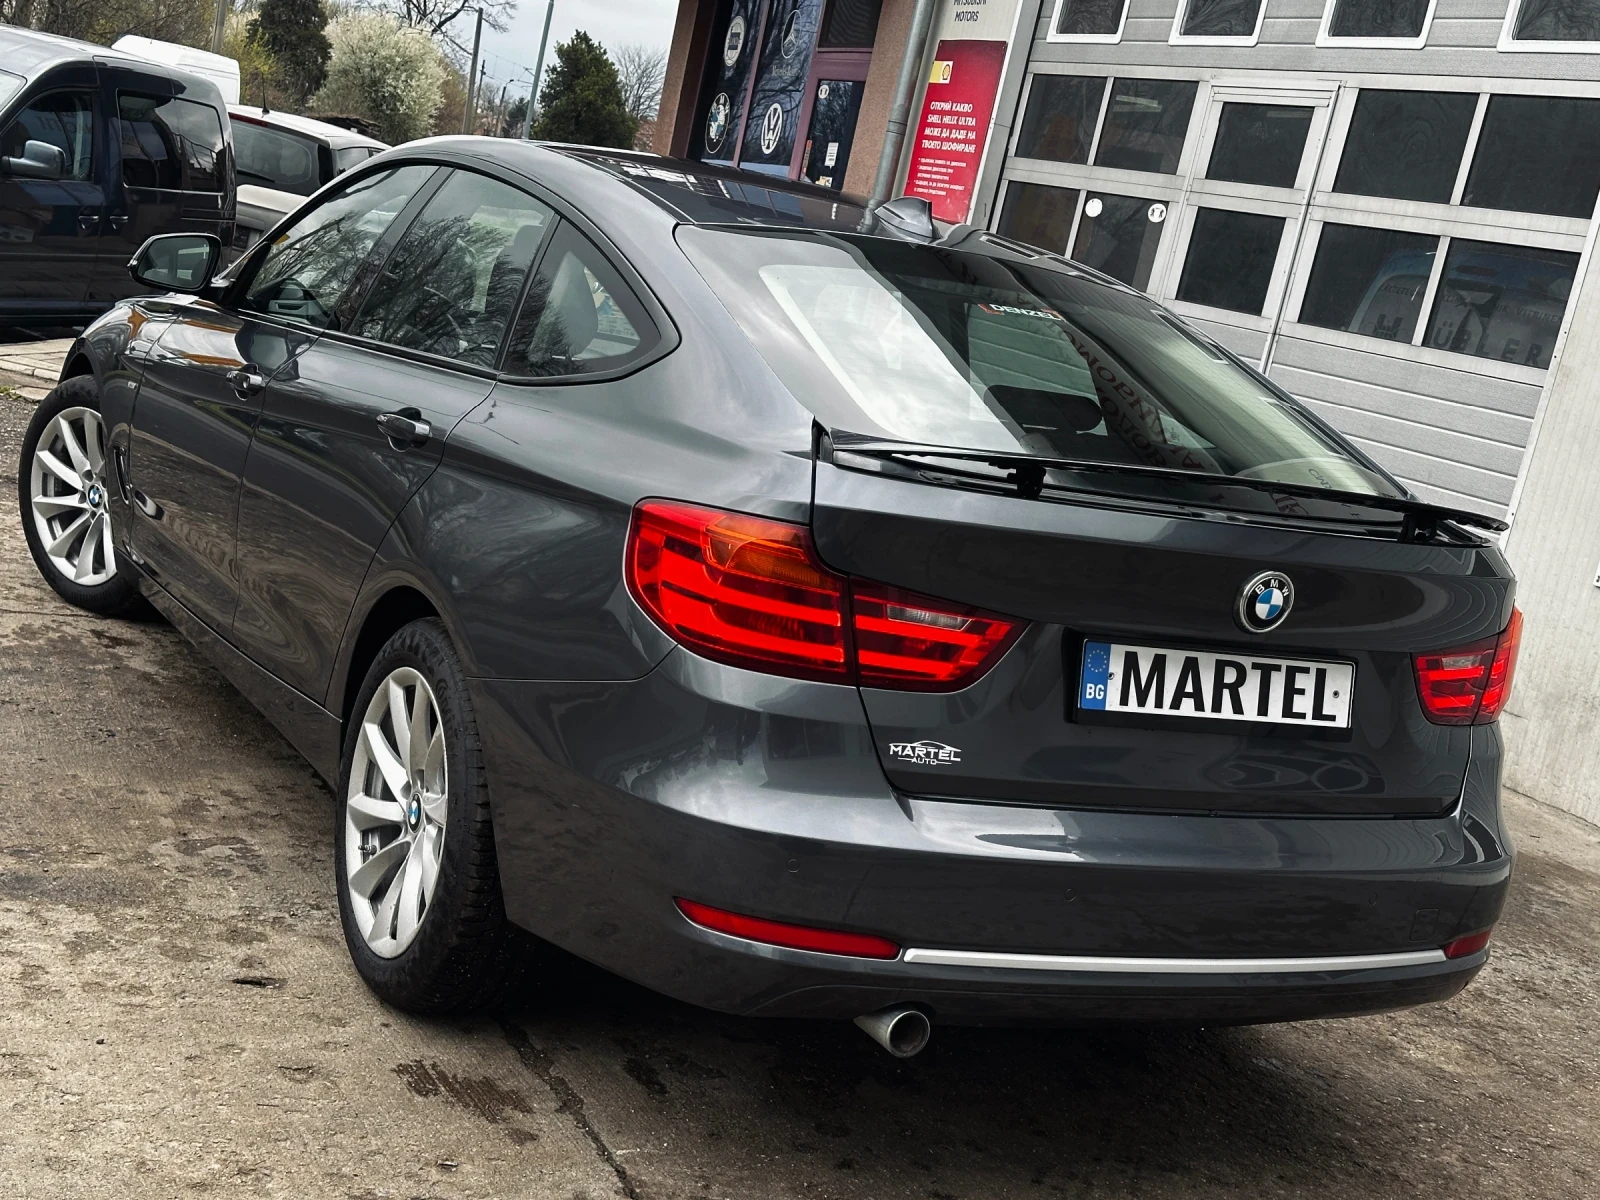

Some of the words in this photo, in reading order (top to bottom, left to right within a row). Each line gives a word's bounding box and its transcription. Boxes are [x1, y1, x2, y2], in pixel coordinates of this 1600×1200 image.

[954, 11, 980, 22] MOTORS
[930, 101, 952, 111] ОТКРИЙ
[952, 102, 973, 113] КАКВО
[927, 114, 942, 124] SHELL
[942, 115, 958, 125] HELIX
[958, 116, 976, 127] ULTRA
[924, 127, 942, 137] МОЖЕ
[941, 128, 949, 138] ДА
[950, 129, 967, 140] ДАДЕ
[967, 130, 976, 140] НА
[921, 140, 941, 149] ТВОЕТО
[942, 142, 976, 153] ШОФИРАНЕ
[989, 303, 1062, 321] DENZEL
[1255, 578, 1290, 597] BMW
[1085, 683, 1105, 700] BG
[1119, 650, 1337, 722] MARTEL
[889, 744, 961, 762] MARTEL
[911, 757, 937, 765] AUTO
